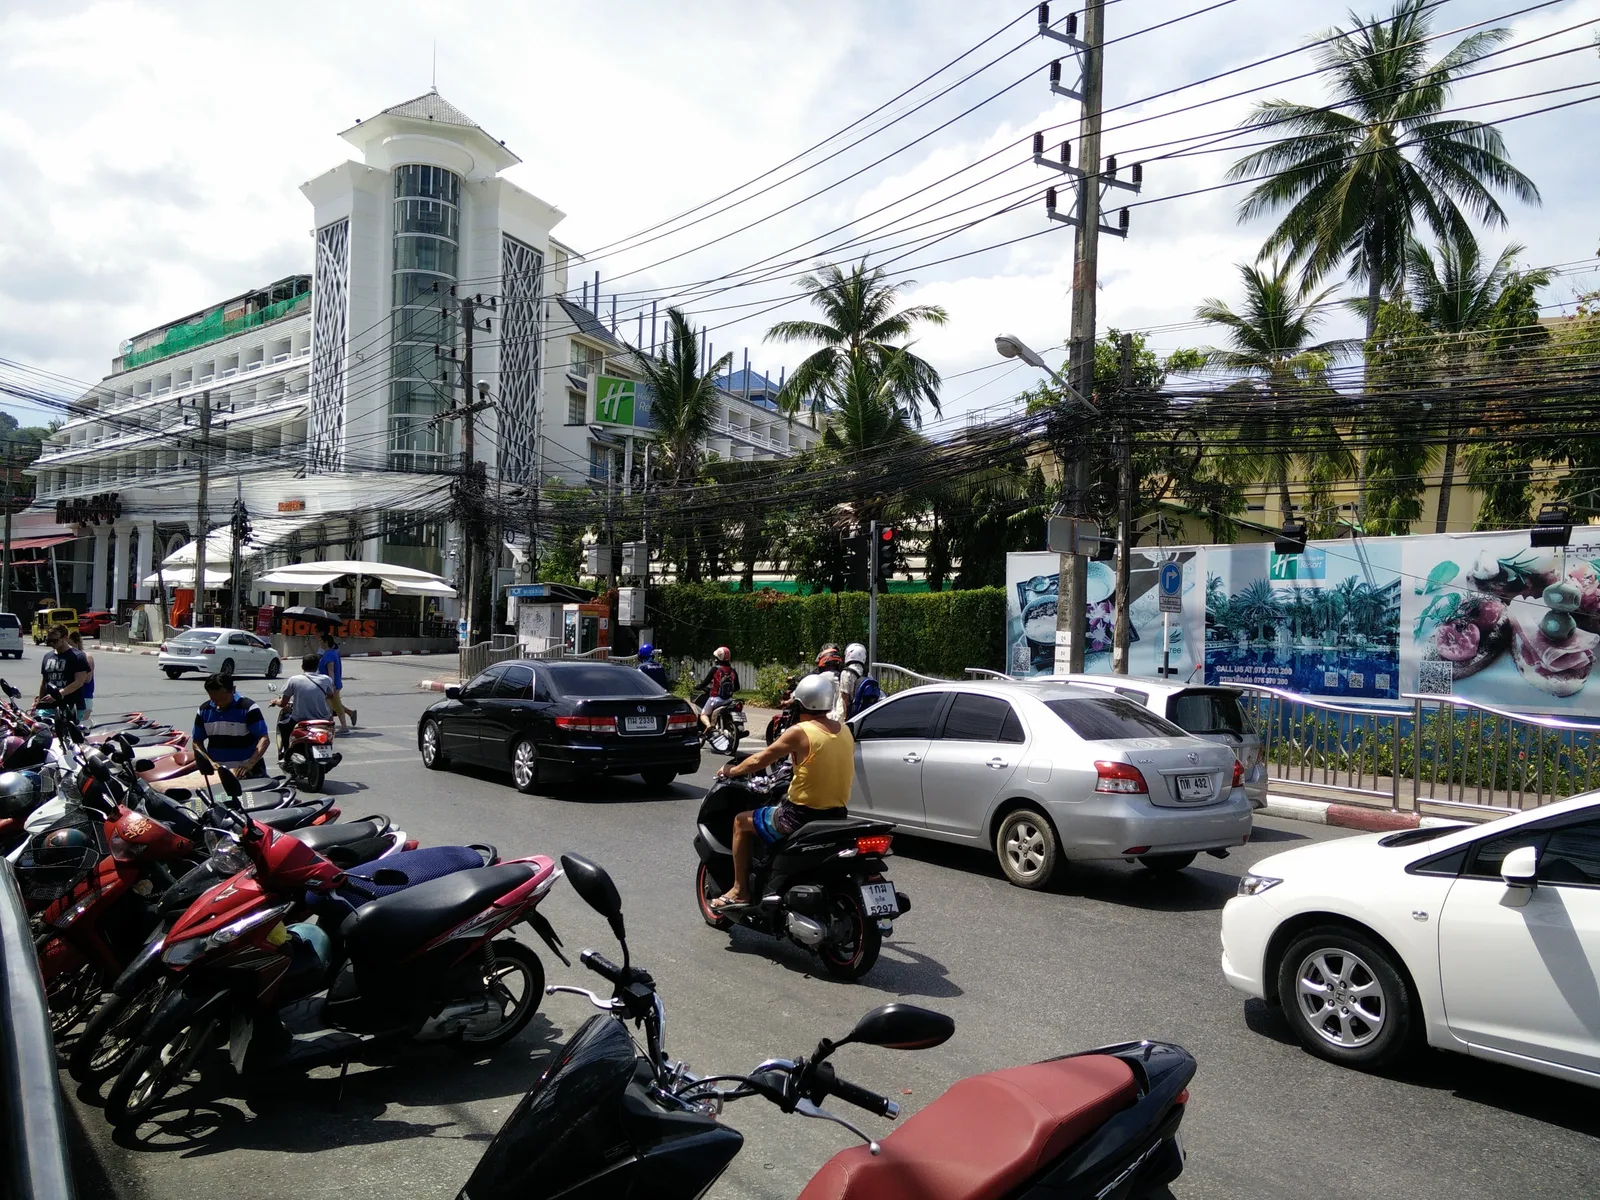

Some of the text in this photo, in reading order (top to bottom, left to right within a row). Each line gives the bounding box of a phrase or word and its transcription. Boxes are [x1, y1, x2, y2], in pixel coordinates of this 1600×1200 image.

[281, 618, 376, 638] HOERS
[1215, 665, 1233, 673] CALL
[1234, 665, 1244, 673] US
[1194, 778, 1208, 789] 432
[870, 904, 893, 915] 5297
